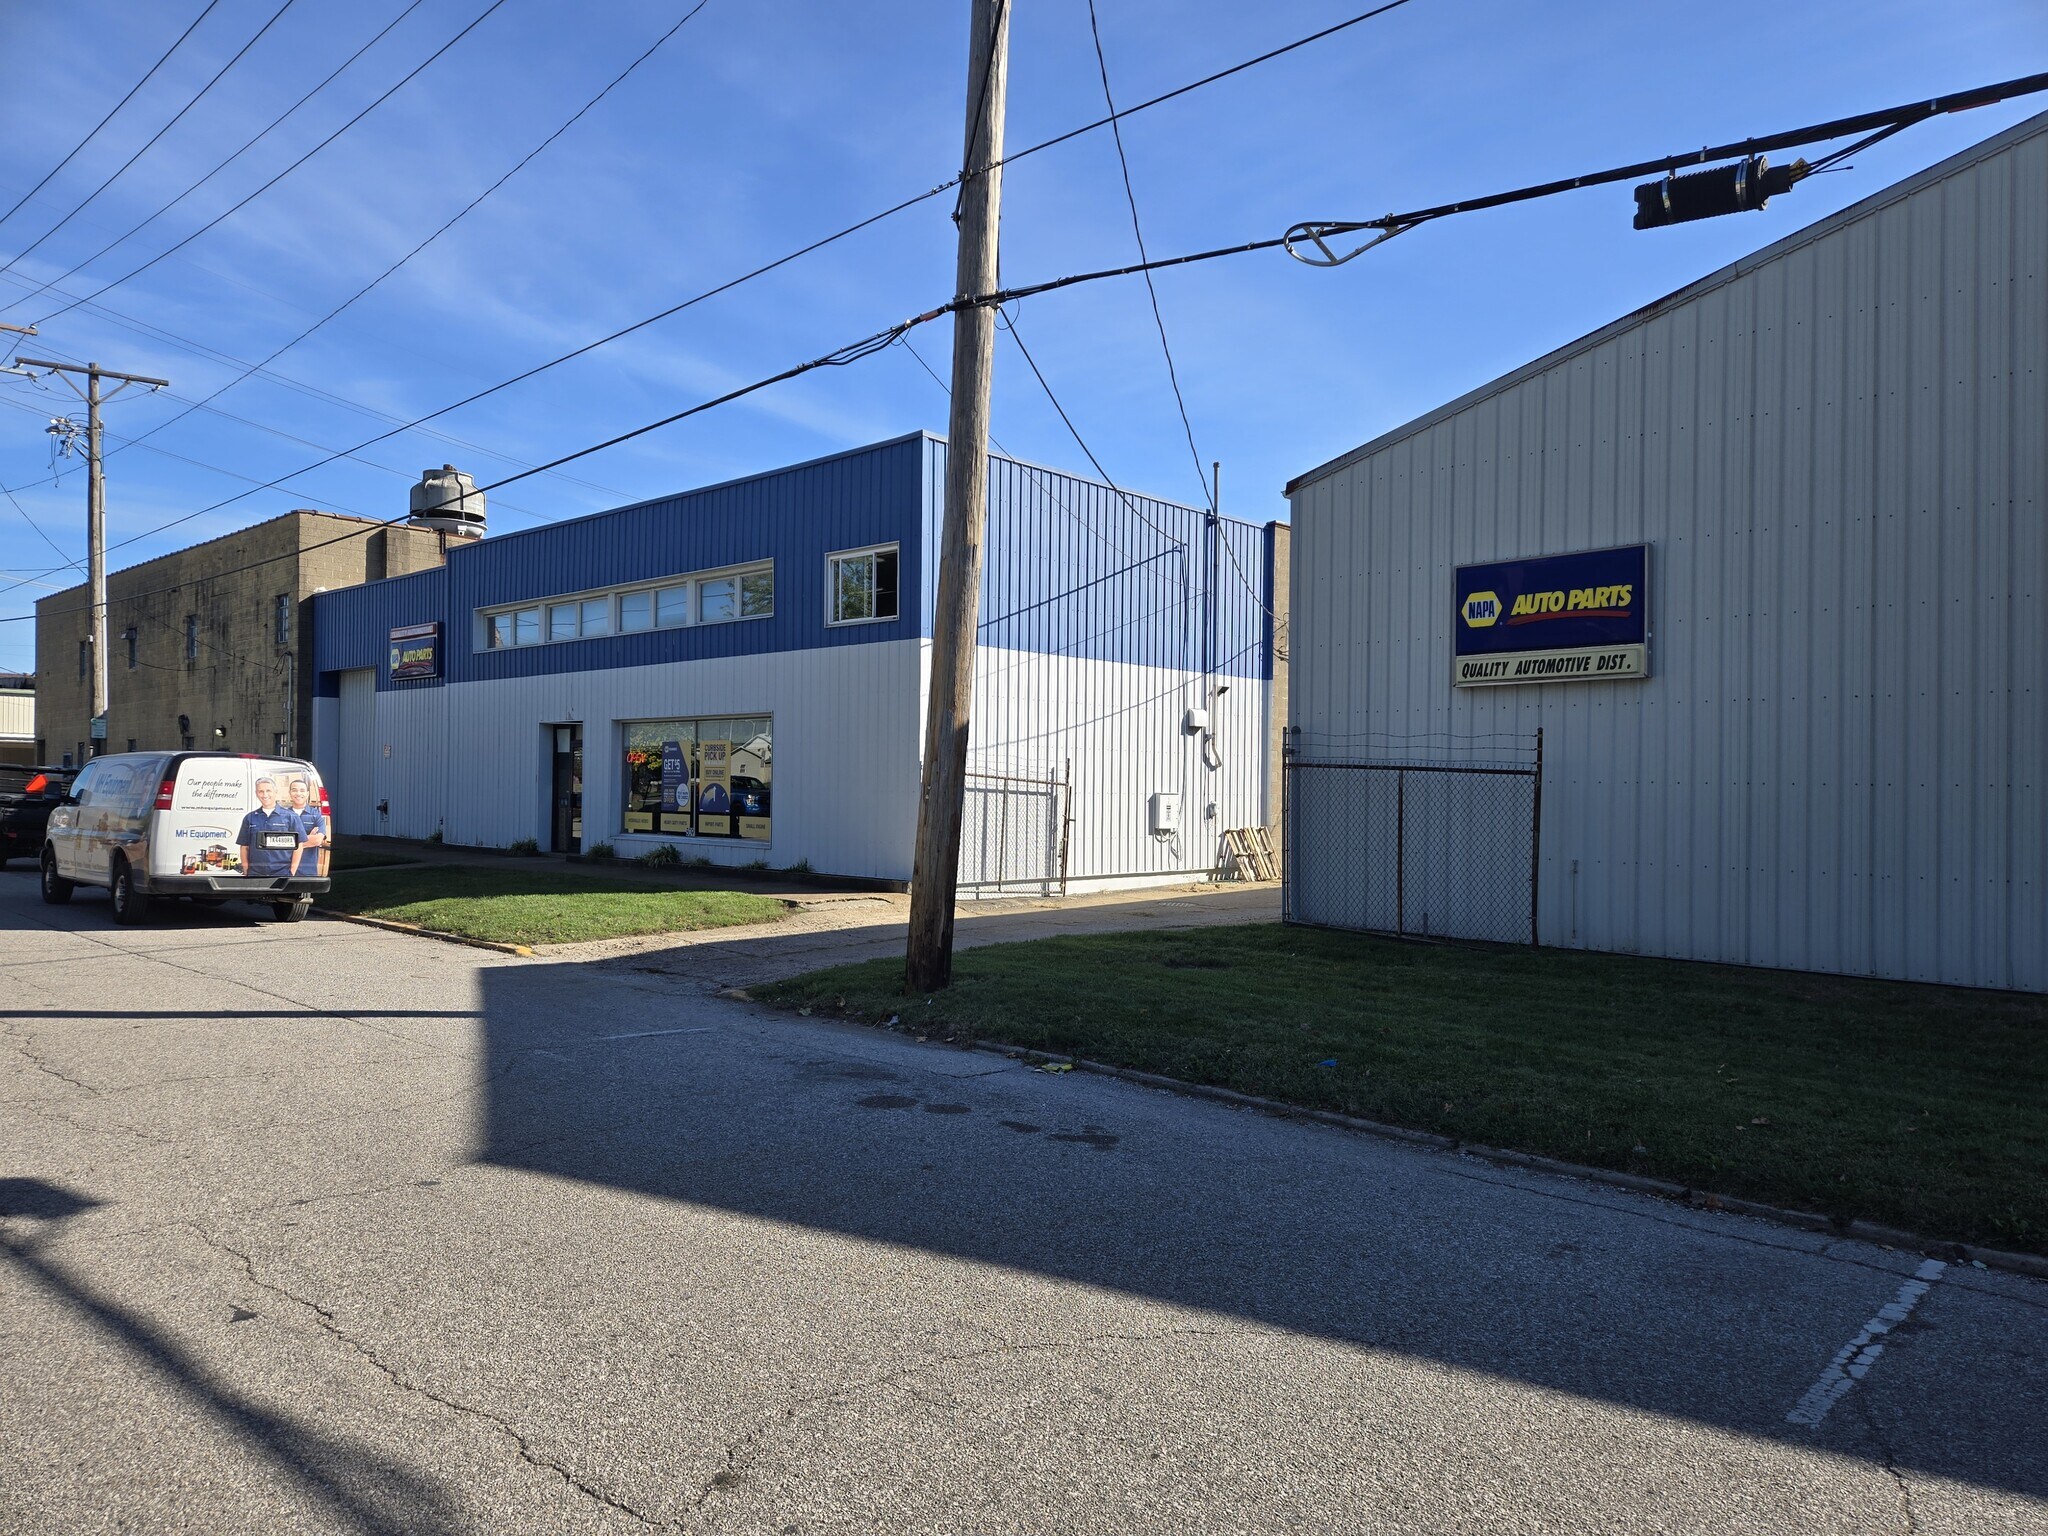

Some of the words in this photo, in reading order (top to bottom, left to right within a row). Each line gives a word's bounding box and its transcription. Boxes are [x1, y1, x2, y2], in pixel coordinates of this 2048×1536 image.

[1510, 591, 1565, 616] AUTO
[1567, 584, 1632, 611] PARTS
[1468, 600, 1495, 619] NAPA
[403, 650, 415, 662] AUTO
[416, 647, 433, 660] PARTS
[1462, 661, 1509, 678] QUALITY
[1515, 656, 1591, 675] AUTOMOTIVE
[1597, 654, 1631, 671] DIST.
[627, 752, 647, 764] OPEN
[705, 752, 718, 760] PICK
[719, 752, 726, 760] UP
[663, 759, 674, 770] GET
[202, 779, 223, 789] people
[224, 780, 242, 788] make
[192, 789, 202, 798] the
[203, 789, 238, 800] difference!
[175, 829, 188, 838] MH
[190, 829, 227, 839] Equipment
